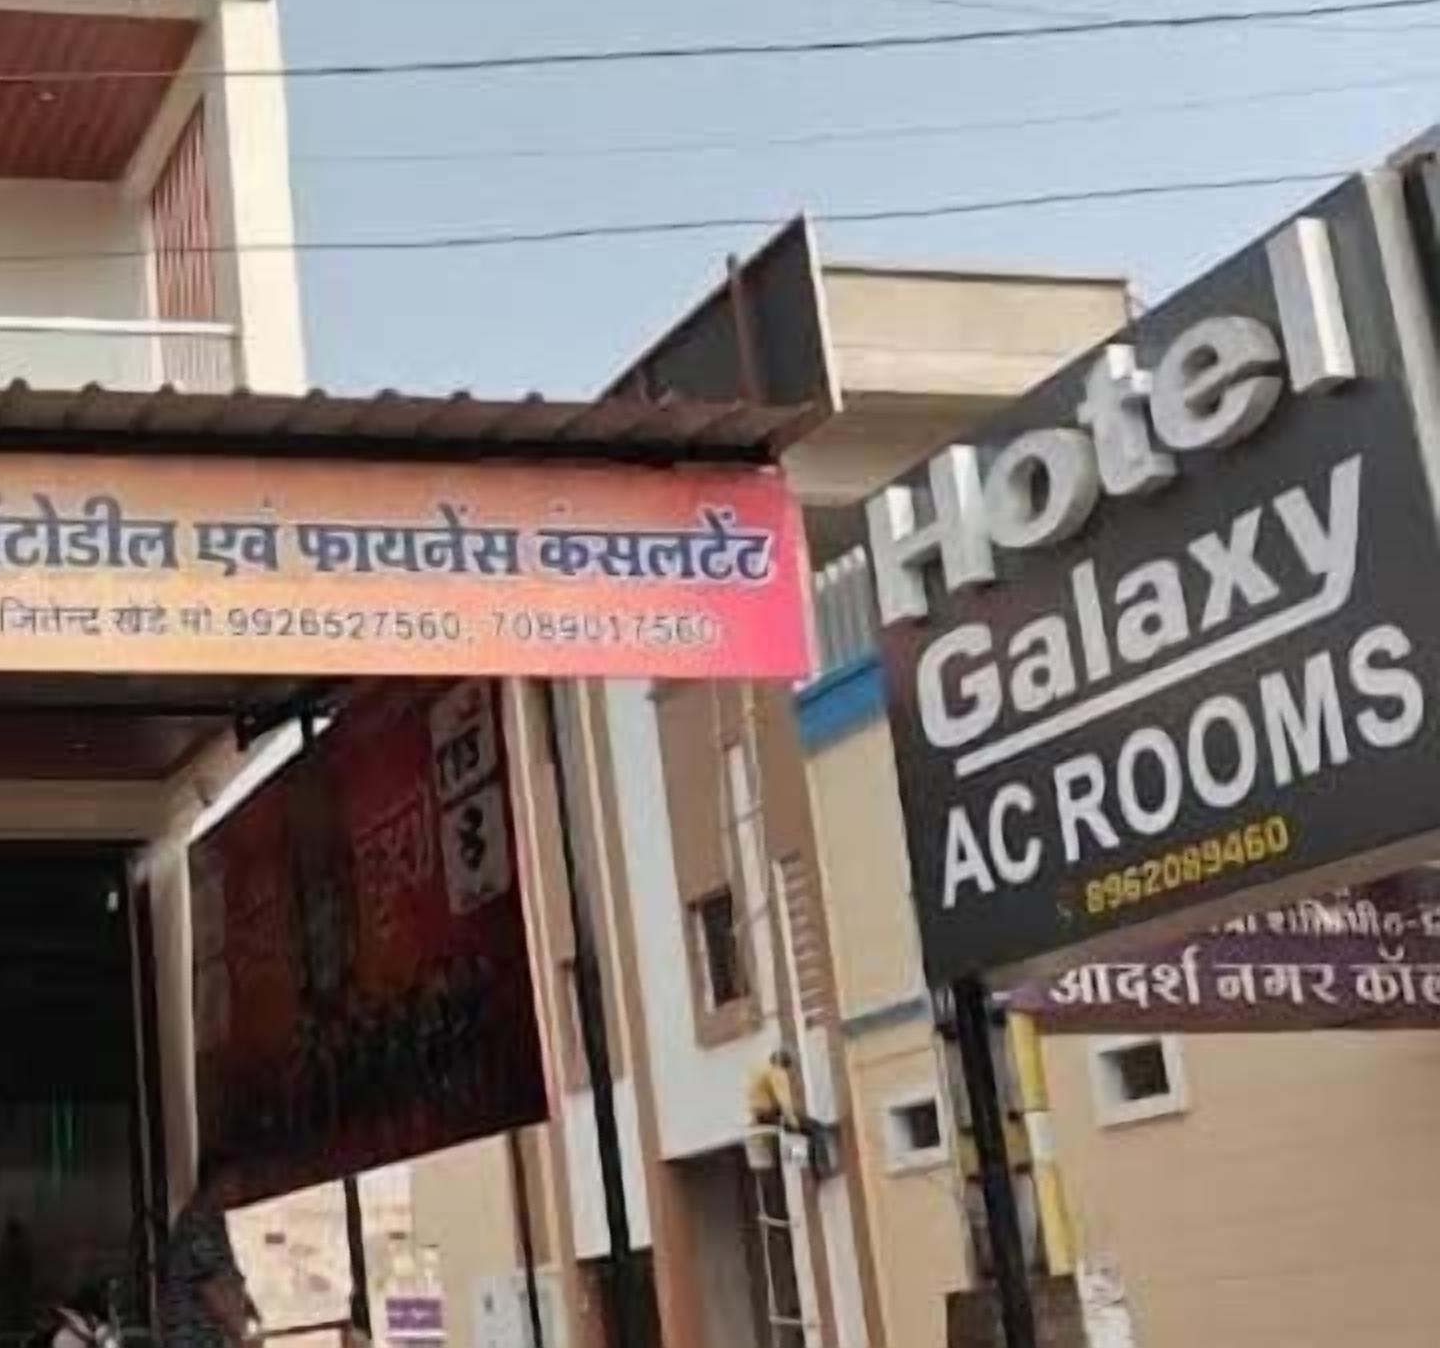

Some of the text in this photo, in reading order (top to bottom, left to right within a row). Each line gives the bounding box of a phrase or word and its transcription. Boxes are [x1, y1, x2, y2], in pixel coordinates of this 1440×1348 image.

[192, 493, 280, 577] एवं
[296, 502, 519, 574] फायनेंस
[865, 215, 1356, 624] Hotel
[915, 454, 1361, 750] Galaxy
[942, 624, 1424, 908] AC ROOMS
[1051, 947, 1201, 1009] आदर्श
[1213, 961, 1338, 1005] नगर
